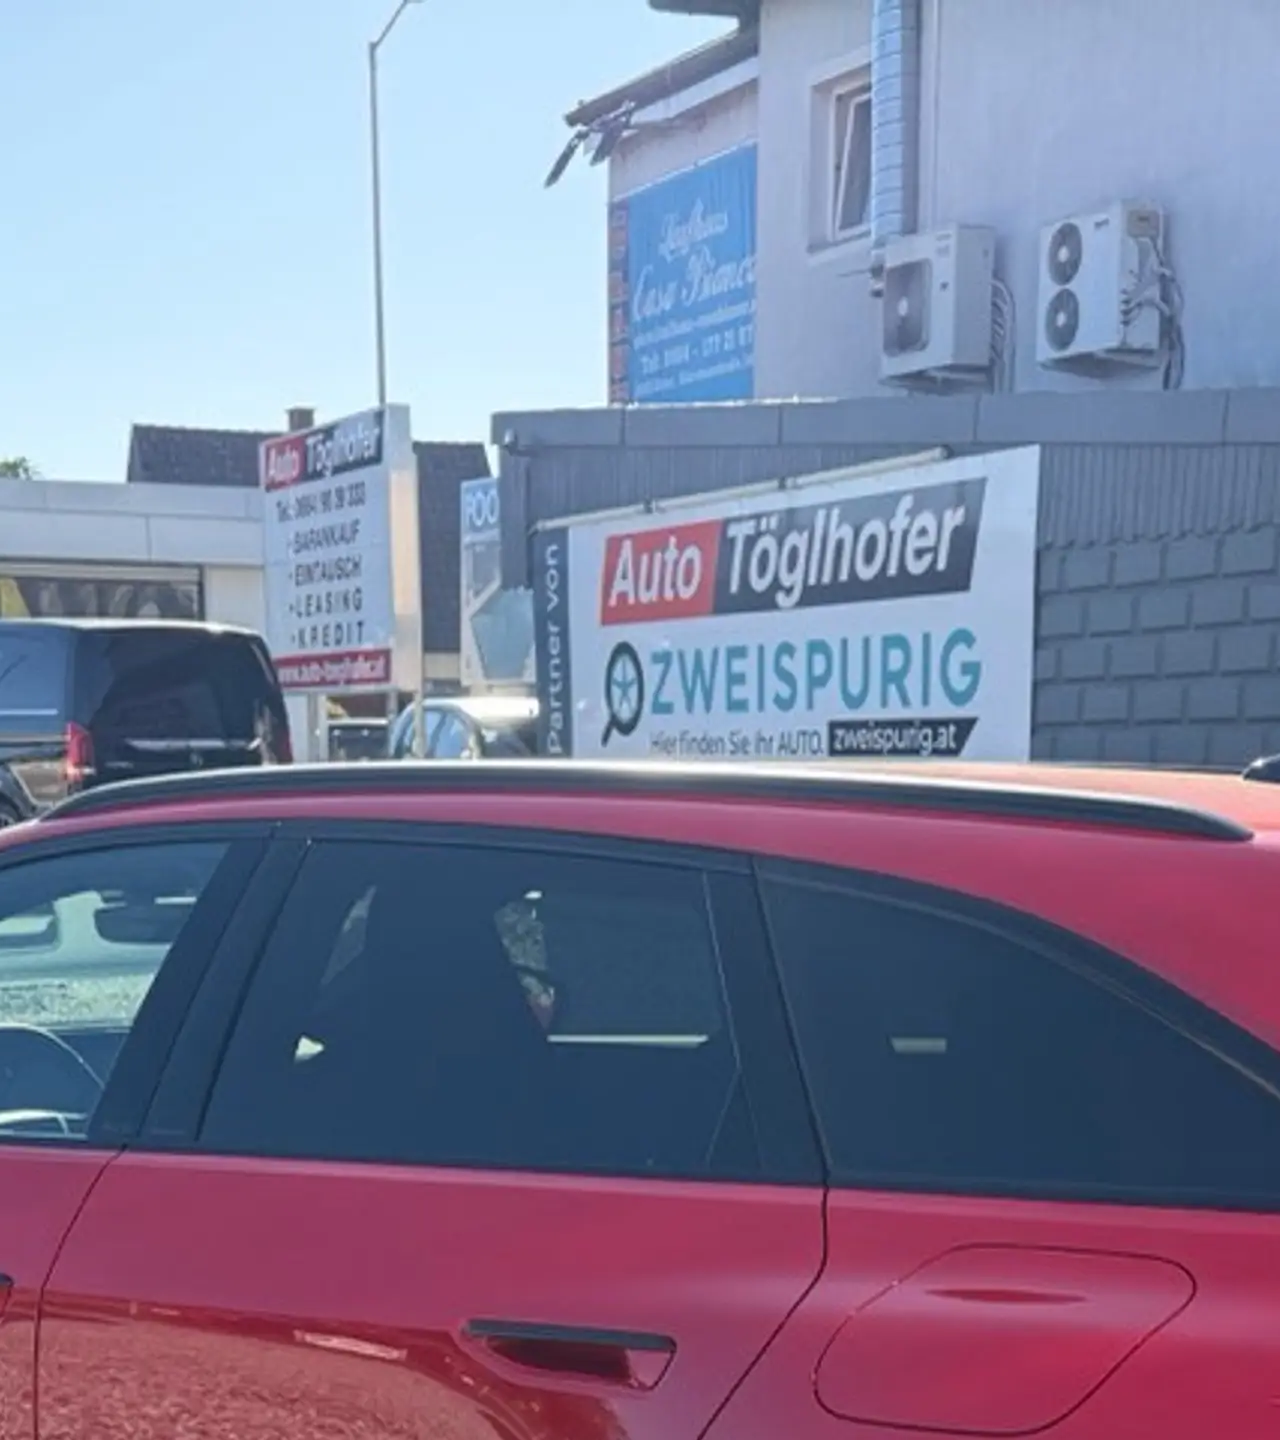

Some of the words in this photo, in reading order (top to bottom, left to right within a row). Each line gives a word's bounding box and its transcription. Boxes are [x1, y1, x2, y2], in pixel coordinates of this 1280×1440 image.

[268, 444, 300, 483] Auto
[609, 537, 702, 607] Auto
[727, 495, 966, 608] Töglhofer
[544, 544, 561, 612] von
[296, 587, 363, 619] LEASING
[298, 620, 365, 650] KREDIT
[651, 628, 982, 714] ZWEISPURIG
[679, 729, 725, 755] finden
[833, 721, 957, 755] zweispurig.at
